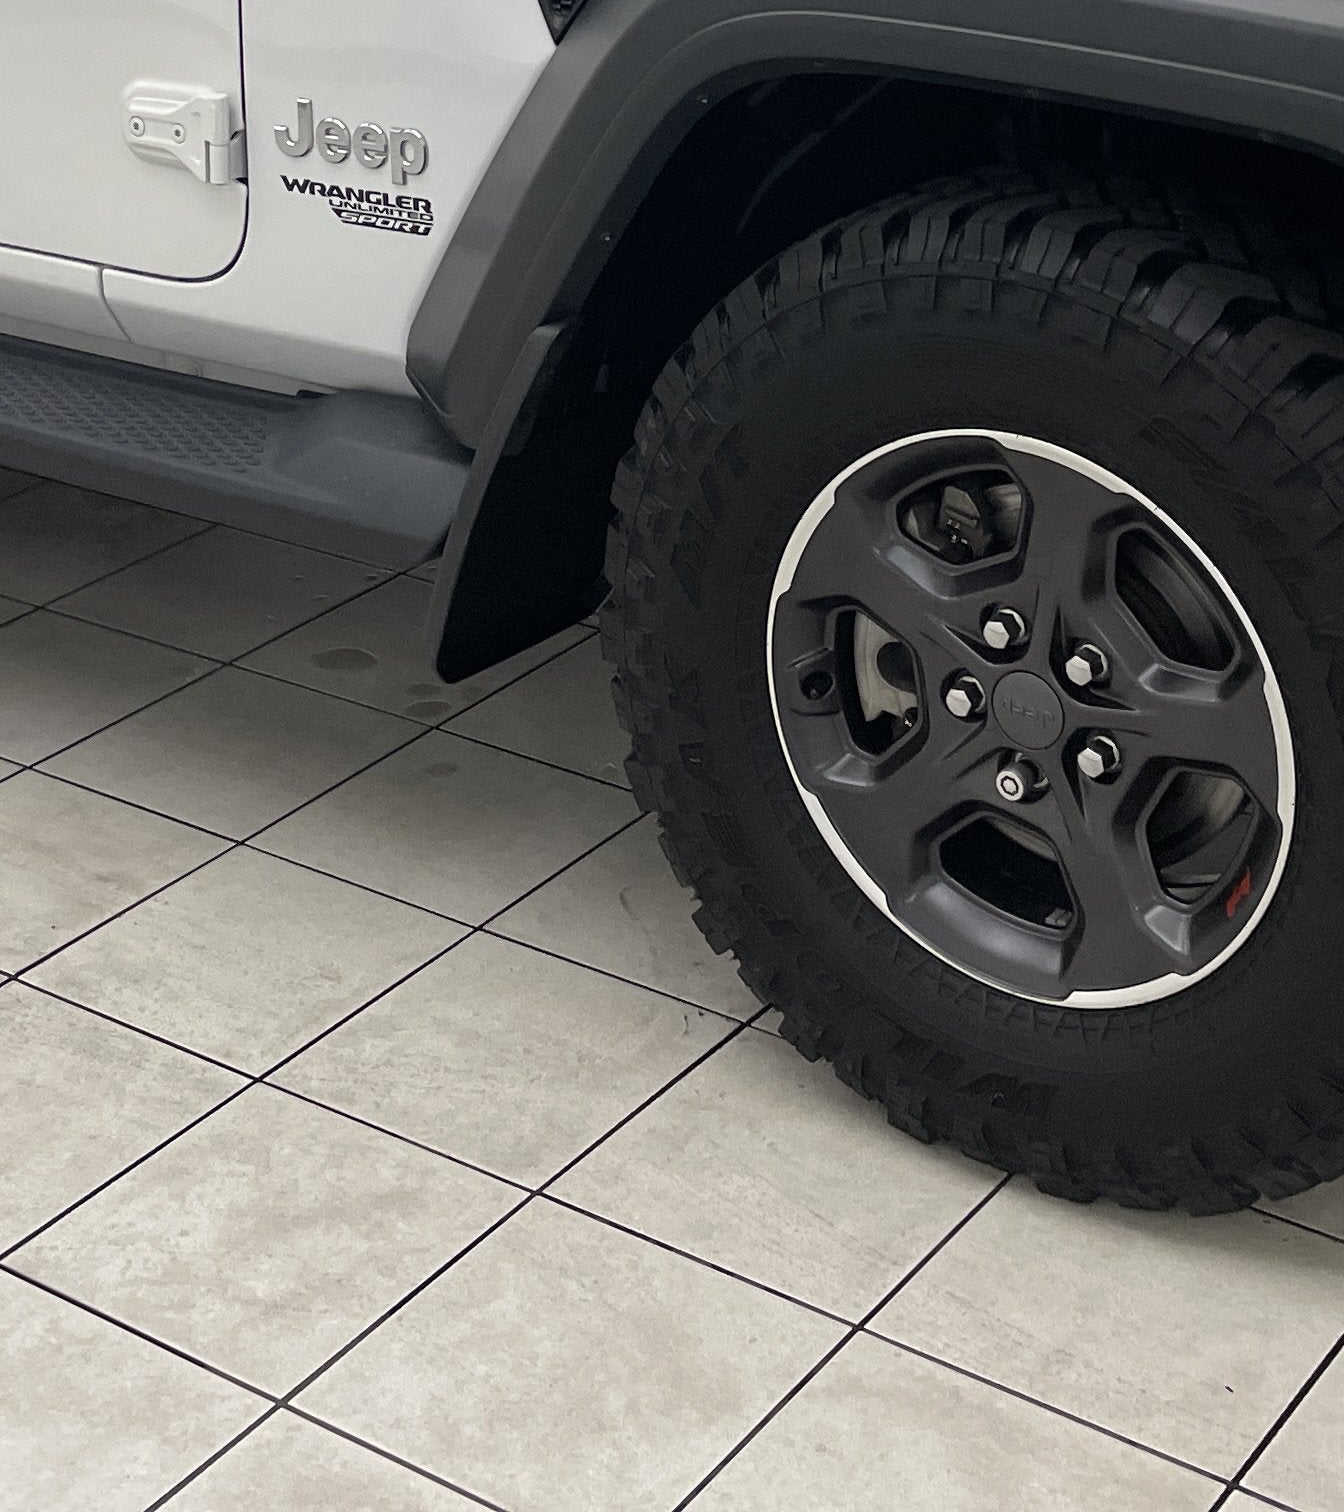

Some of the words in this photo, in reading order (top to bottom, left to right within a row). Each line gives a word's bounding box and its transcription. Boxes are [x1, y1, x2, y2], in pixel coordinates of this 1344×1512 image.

[273, 97, 429, 185] Jeep
[280, 175, 432, 212] WRANGLER
[328, 199, 434, 222] UNLIMITED
[341, 211, 431, 234] SPORT
